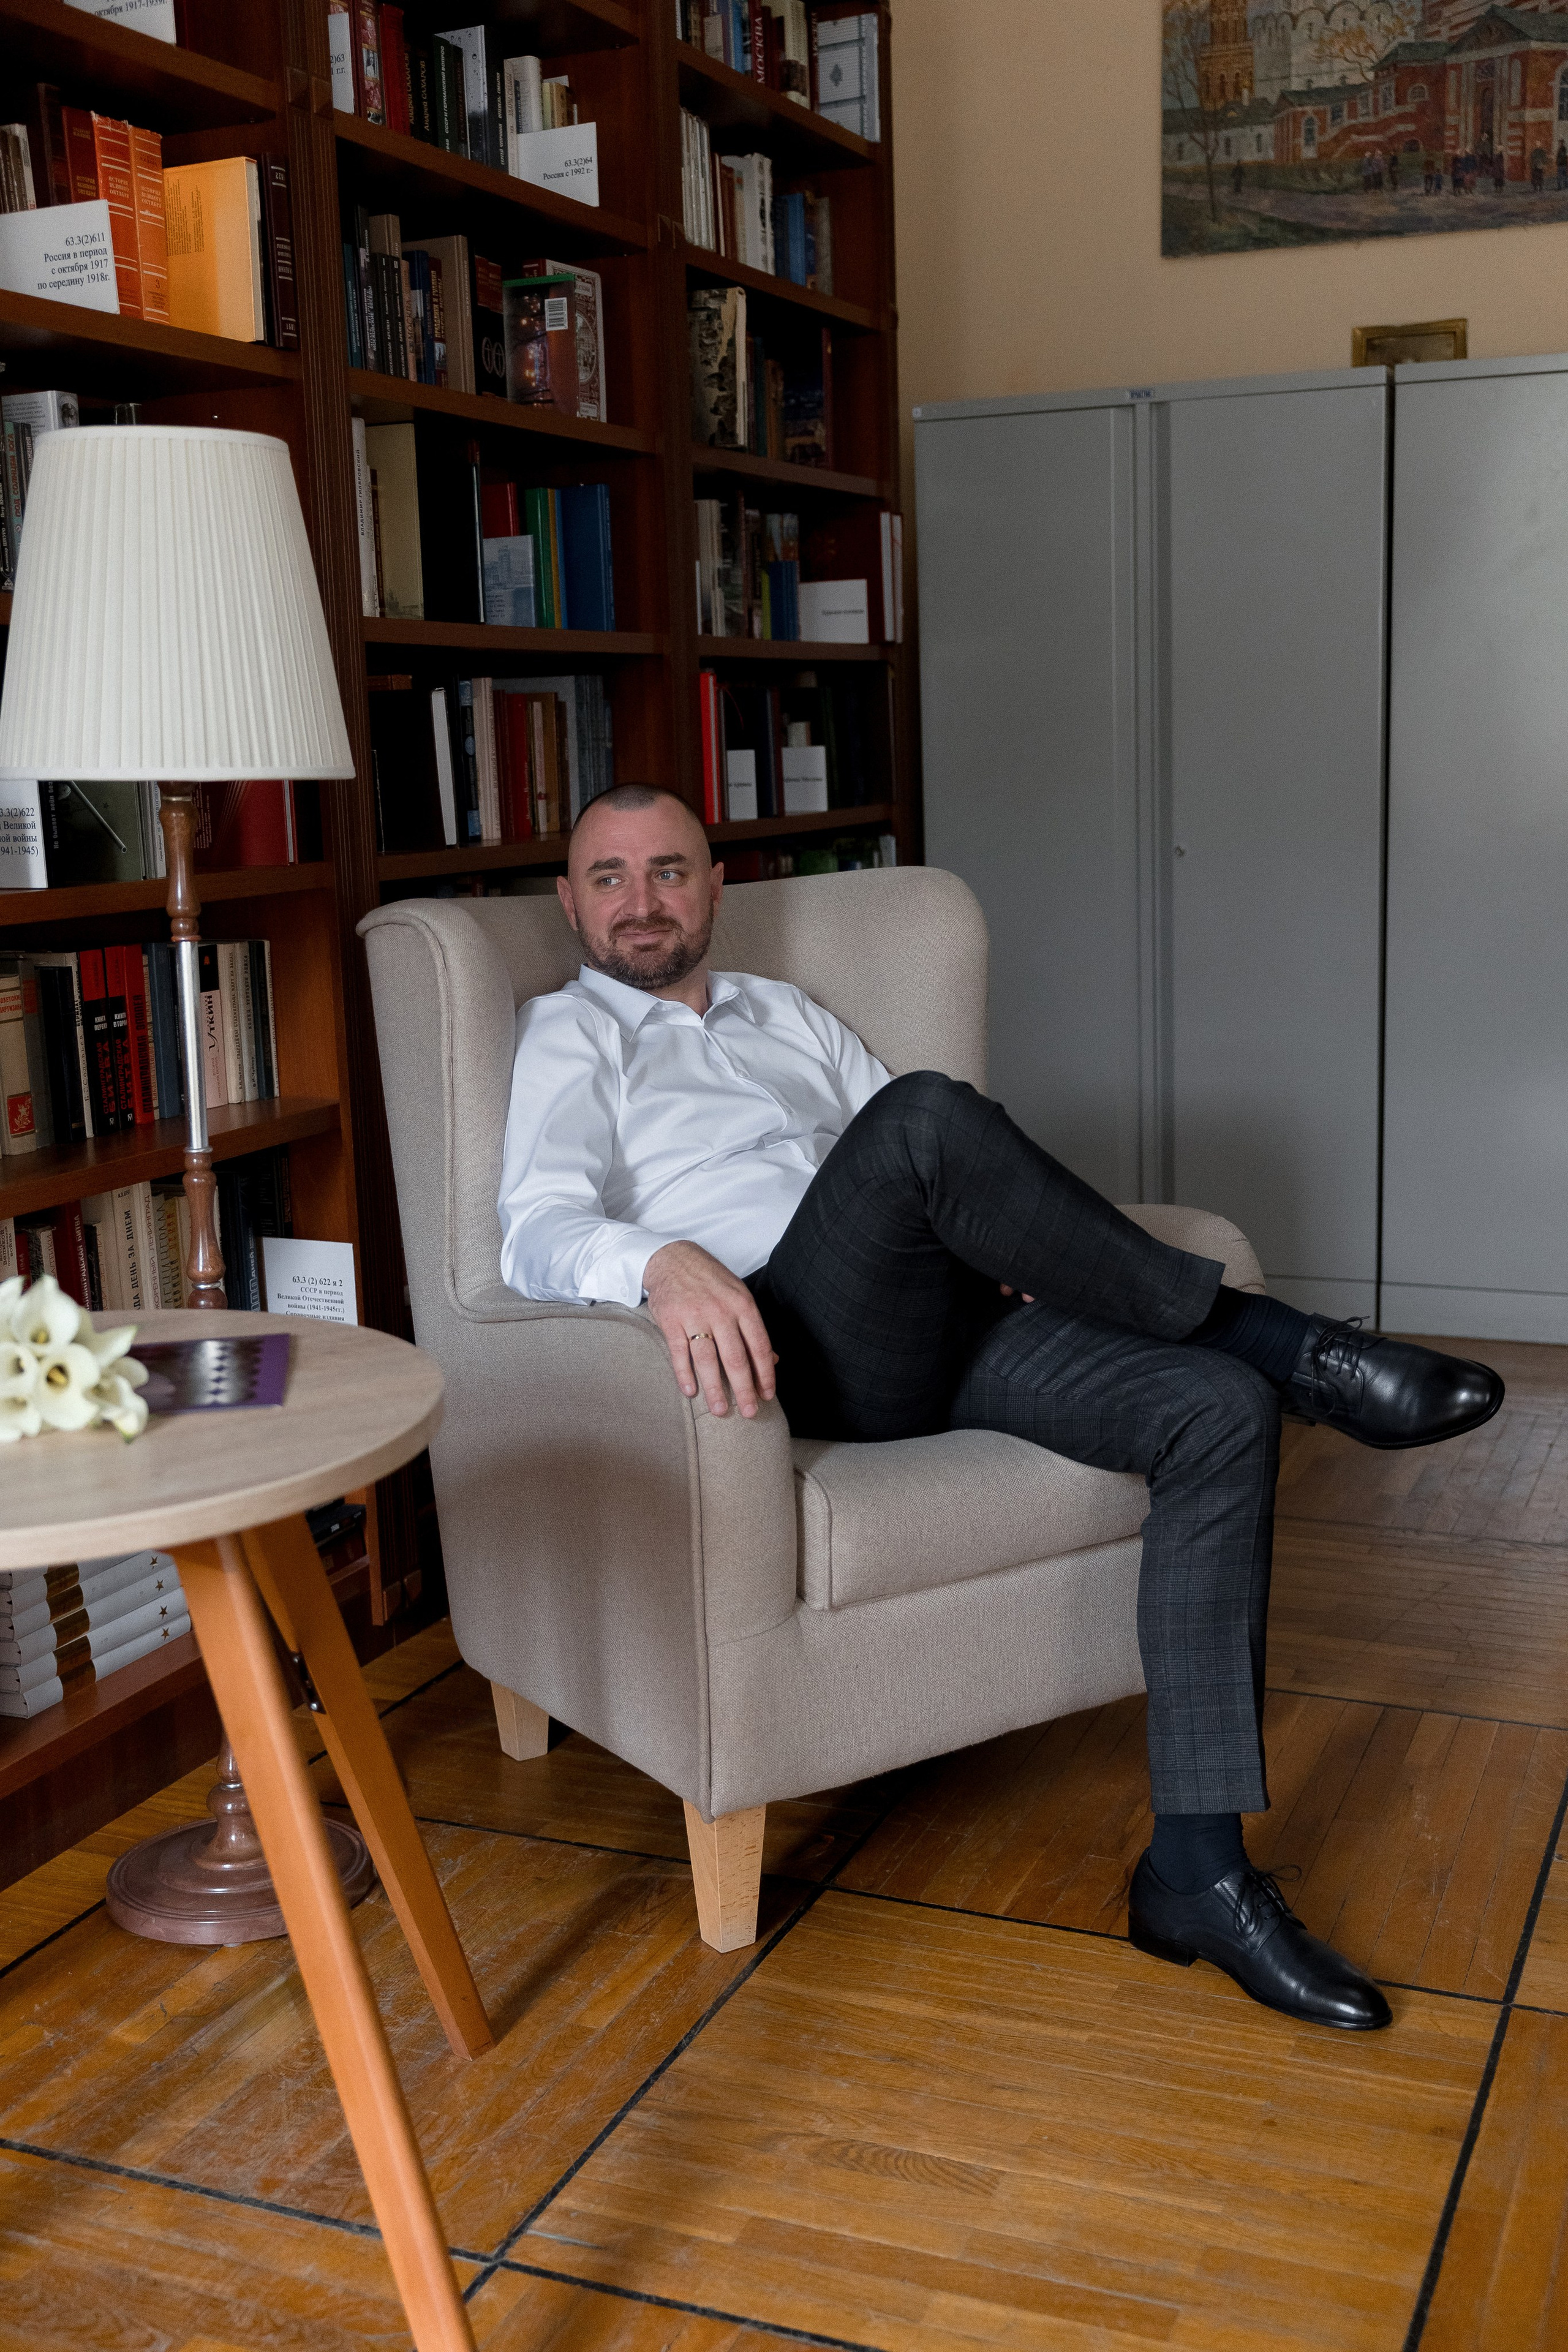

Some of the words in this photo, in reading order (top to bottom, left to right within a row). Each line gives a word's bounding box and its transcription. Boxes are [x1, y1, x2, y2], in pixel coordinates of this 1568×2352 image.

[754, 17, 766, 84] МОСКВА
[564, 157, 593, 167] 63.3(2)64
[571, 168, 585, 176] 1992
[108, 175, 129, 186] ИСТОРИЯ
[109, 189, 130, 200] ОКТЯБРЯ
[141, 186, 161, 197] ИСТОРИЯ
[141, 198, 162, 209] ОКТЯБРЯ
[65, 232, 105, 246] 63.3(2)611
[44, 252, 72, 263] Россия
[74, 251, 78, 260] в
[80, 247, 108, 260] период
[58, 262, 89, 274] октября
[91, 258, 109, 270] 1917
[49, 277, 85, 290] середину
[87, 272, 111, 284] 1918г.
[155, 278, 161, 289] 3
[10, 455, 19, 496] СОЛНЦЕМ
[3, 821, 37, 830] Великой
[13, 834, 37, 843] войны
[53, 840, 59, 850] Не
[1, 846, 39, 857] 941-1945)
[132, 994, 145, 1031] ЭПОПЕЯ
[206, 995, 218, 1050] УТКИН
[96, 1041, 110, 1114] СТАЛИНГРАДСКАЯ
[102, 1040, 116, 1113] БИТВА
[115, 1038, 128, 1110] СТАЛИНГРАДСКАЯ
[122, 1036, 134, 1109] БИТВА
[137, 1035, 153, 1113] СТАЛИНГРАДСКАЯ
[73, 1214, 83, 1242] БИТВА
[124, 1210, 134, 1240] ДНЕМ
[144, 1194, 154, 1251] ЛЕНИНГРАД
[47, 1234, 56, 1276] АЛТИКИ
[127, 1245, 135, 1259] ЗА
[129, 1262, 139, 1289] ДЕНЬ
[149, 1256, 160, 1310] КОРЕННЫЙ
[307, 1276, 317, 1286] (2)
[302, 1295, 344, 1304] Отечественной
[307, 1304, 345, 1314] (1941-1945гг.)
